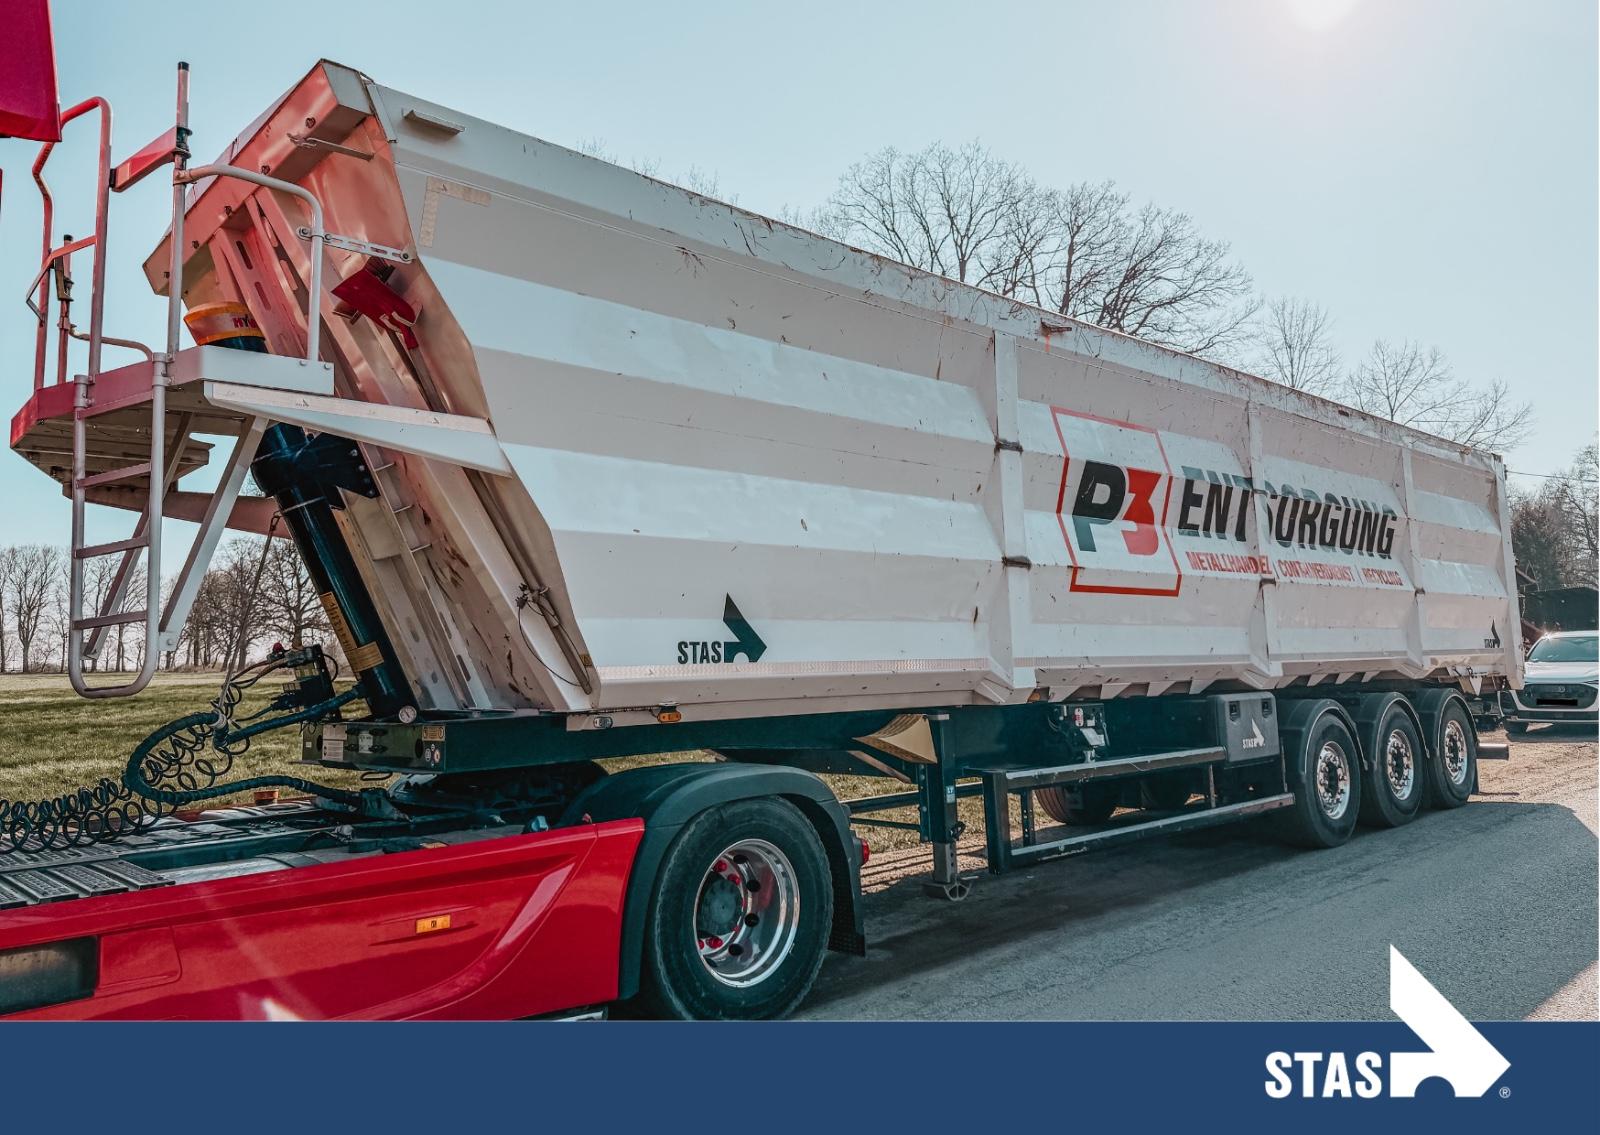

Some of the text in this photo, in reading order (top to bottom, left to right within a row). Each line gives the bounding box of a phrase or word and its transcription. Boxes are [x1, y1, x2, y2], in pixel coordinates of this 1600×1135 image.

[1072, 459, 1159, 556] P3
[1185, 551, 1273, 575] METALLHANDEL
[677, 640, 722, 664] STAS
